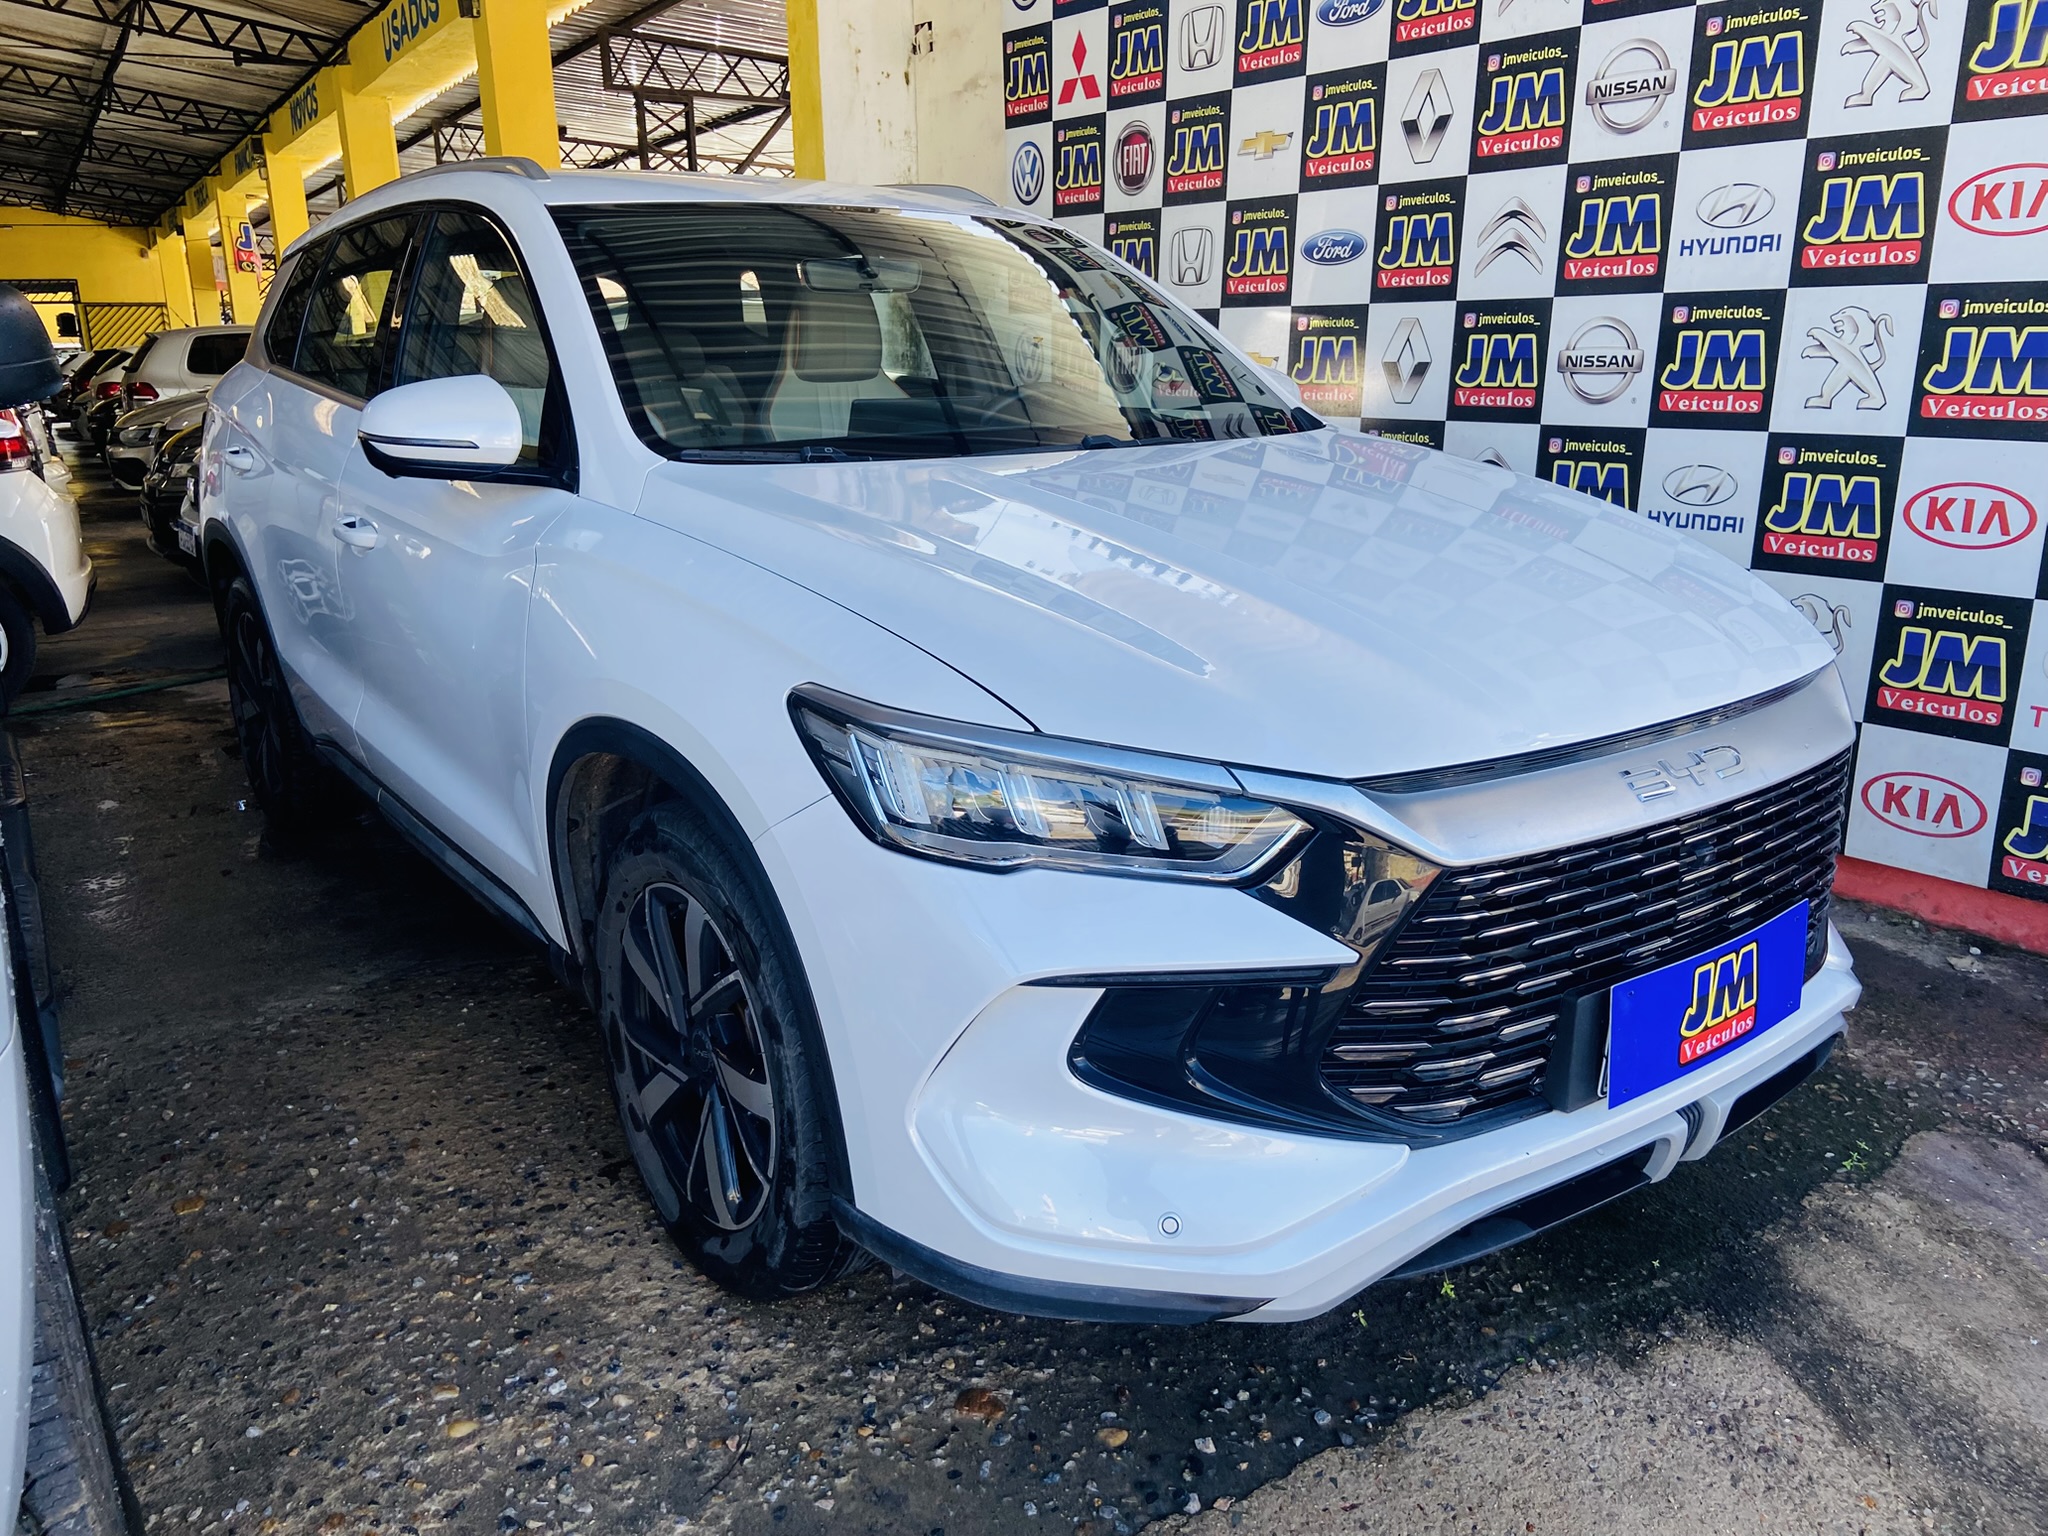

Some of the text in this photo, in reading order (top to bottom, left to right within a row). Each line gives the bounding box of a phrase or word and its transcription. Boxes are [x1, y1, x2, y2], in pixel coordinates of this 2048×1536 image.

[382, 0, 439, 62] USADOS
[1239, 0, 1303, 54] JM
[1724, 6, 1808, 32] jmveiculos_
[1006, 51, 1049, 100] JM
[1111, 24, 1163, 79] JM
[1694, 30, 1804, 107] JM
[1478, 68, 1565, 135] JM
[1594, 75, 1667, 98] NISSAN
[1974, 76, 2048, 97] Veícu
[1167, 123, 1224, 176] JM
[1306, 98, 1376, 158] JM
[1056, 142, 1101, 189] JM
[1123, 143, 1147, 177] FIAT
[1838, 146, 1931, 169] jmveiculos_
[1803, 172, 1924, 244] JM
[1971, 179, 2048, 221] KIA
[1226, 226, 1289, 277] JM
[1313, 235, 1352, 260] Ford
[1378, 212, 1454, 269] JM
[1564, 194, 1661, 258] JM
[1680, 234, 1782, 256] HYUNDAI
[1691, 305, 1770, 322] jmveiculos_
[1292, 336, 1358, 385] JM
[1455, 334, 1538, 388] JM
[1566, 354, 1634, 368] NISSAN
[1660, 329, 1766, 390] JM
[1923, 326, 2048, 395] JM
[1798, 448, 1886, 468] jmveiculos_
[1648, 509, 1744, 533] HYUNDAI
[1765, 472, 1880, 539] JM
[1926, 496, 2011, 537] KIA
[1916, 602, 2013, 629] jmveiculos_
[1879, 626, 2006, 703] JM
[1618, 745, 1743, 803] BYD
[1882, 781, 1963, 829] KIA
[2004, 795, 2048, 859] J
[1680, 941, 1758, 1038] JM
